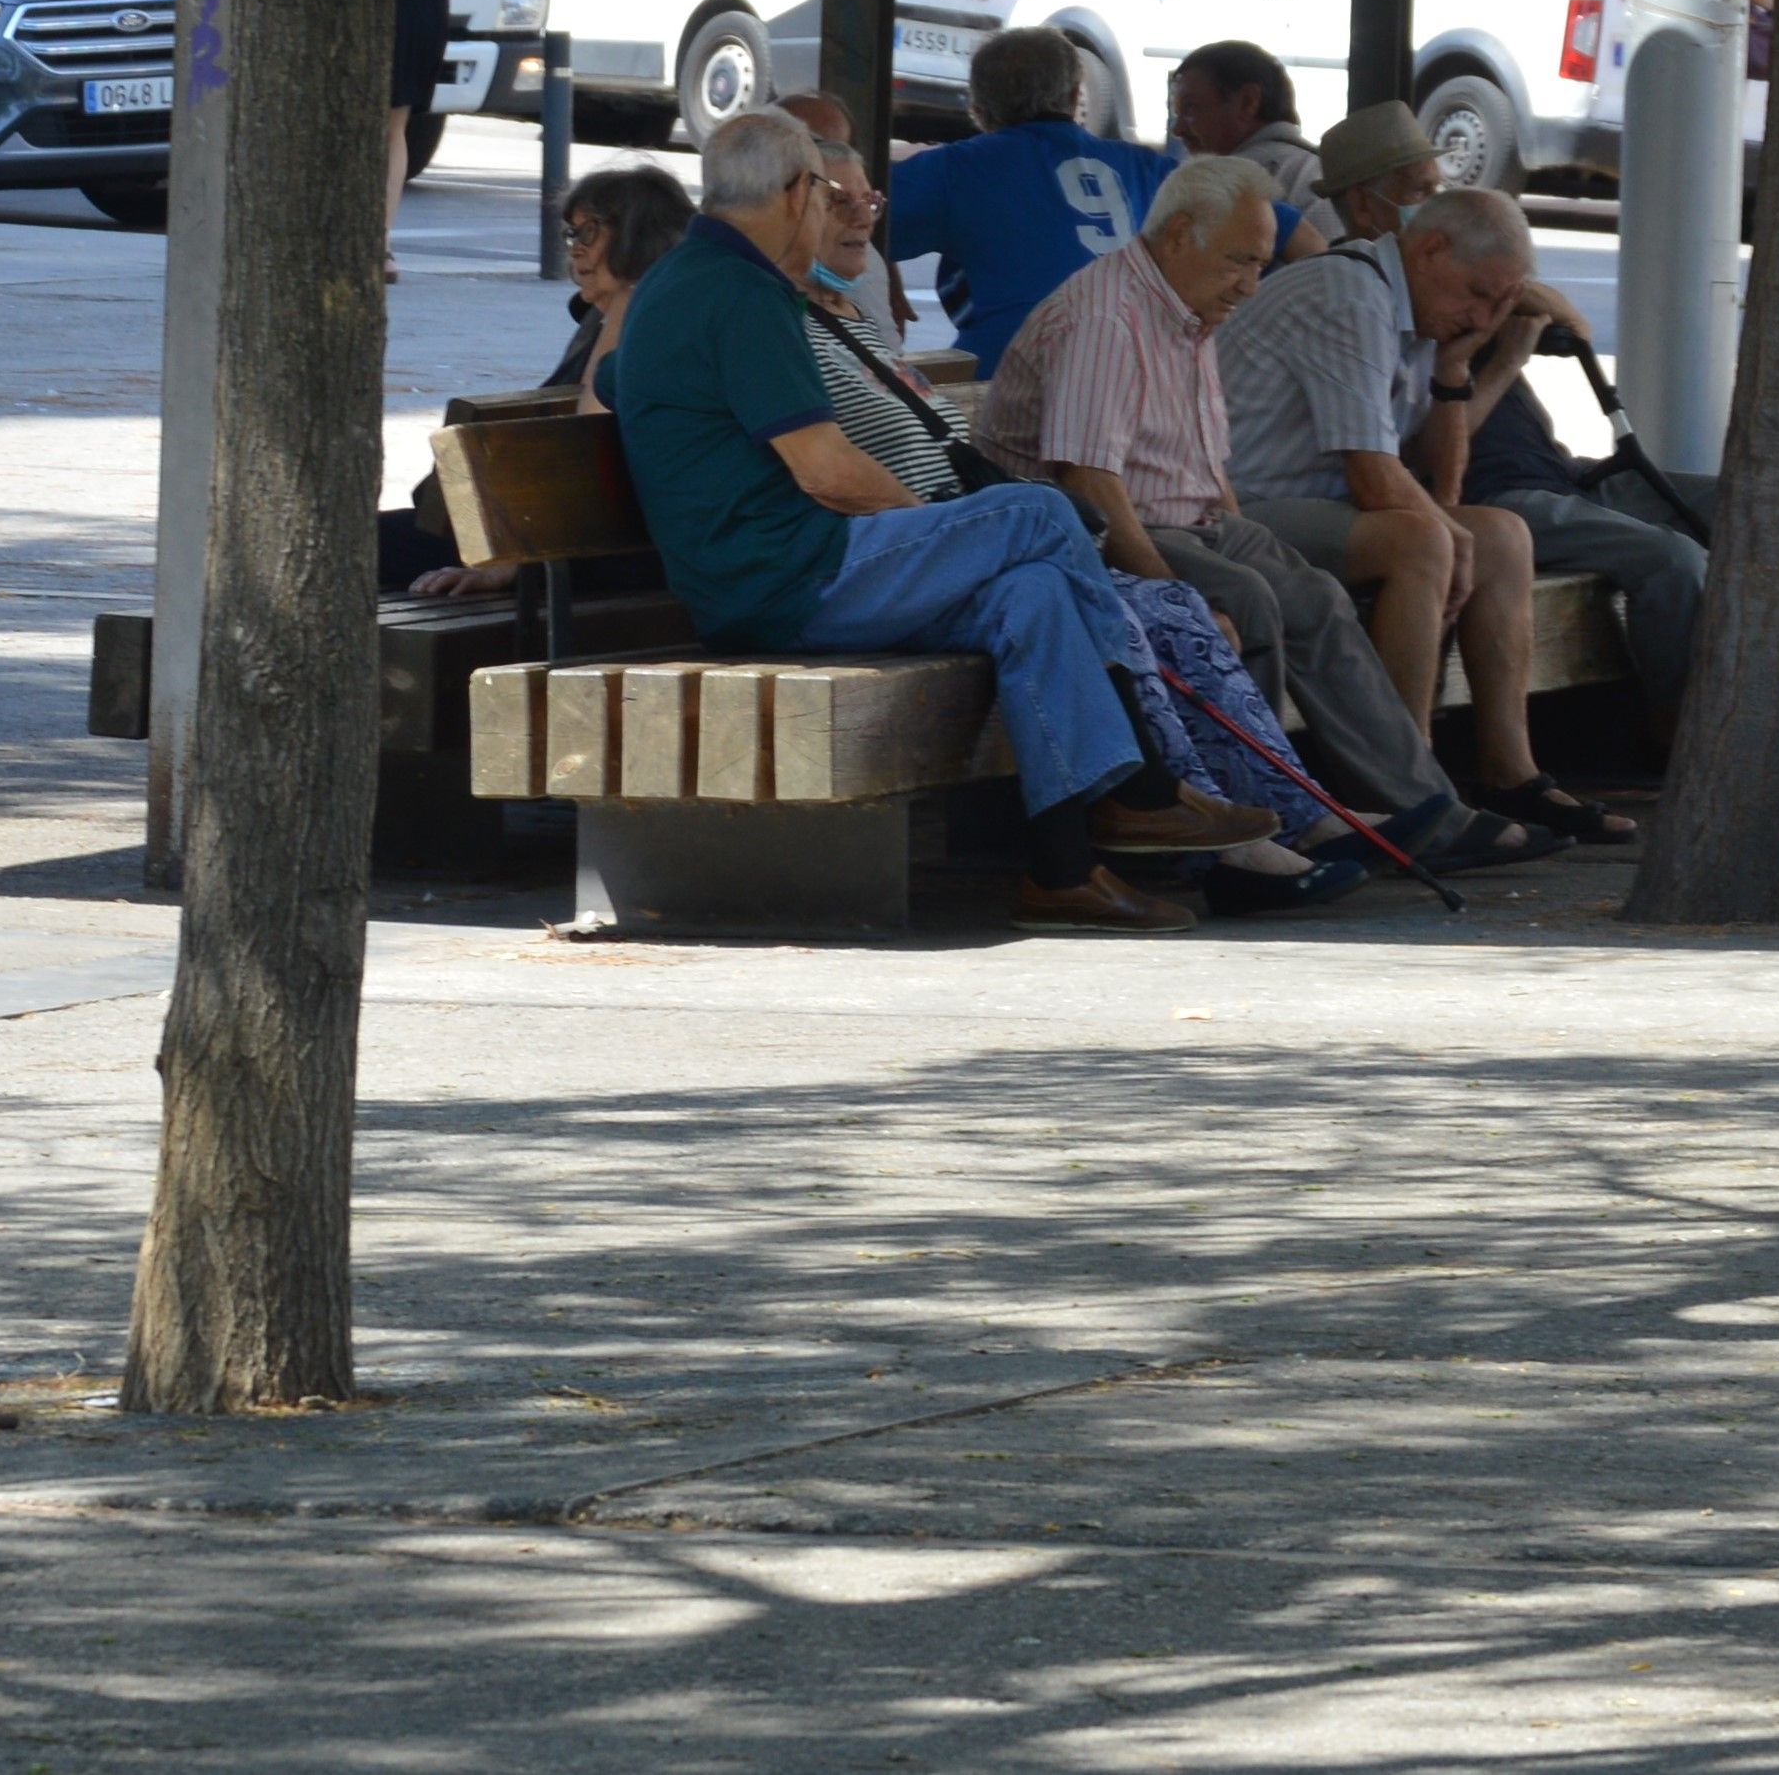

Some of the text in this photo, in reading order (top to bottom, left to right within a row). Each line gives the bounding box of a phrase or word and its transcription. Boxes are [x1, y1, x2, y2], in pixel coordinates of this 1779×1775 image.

[903, 28, 948, 52] 4559
[100, 80, 174, 108] 0648 L
[1055, 156, 1132, 257] 9
